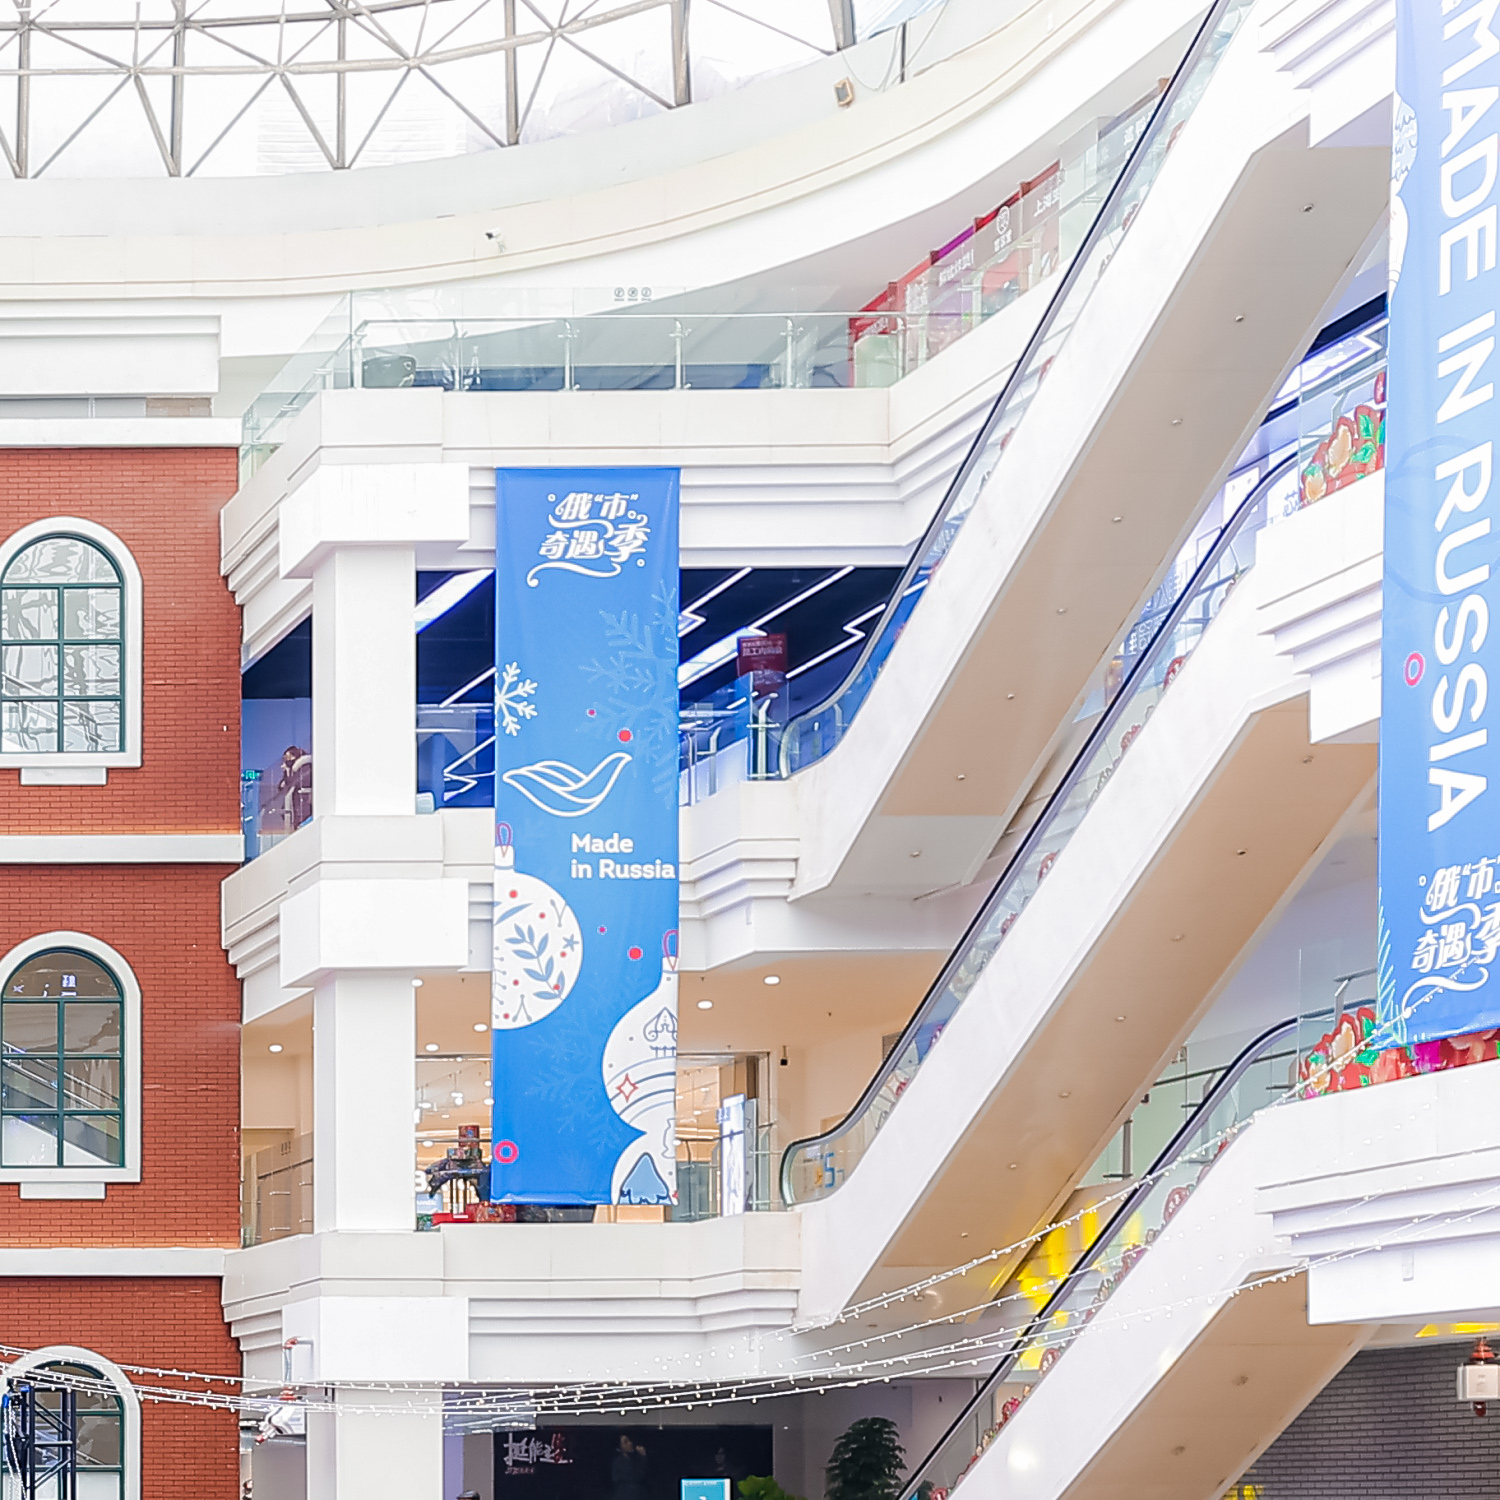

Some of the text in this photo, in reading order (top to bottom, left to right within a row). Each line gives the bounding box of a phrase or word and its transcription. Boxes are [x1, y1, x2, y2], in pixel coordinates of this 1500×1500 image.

[1427, 0, 1500, 832] MADE IN RUSSIA
[538, 524, 651, 562] 奇遇季
[571, 832, 633, 853] Made
[571, 859, 676, 879] in Russia
